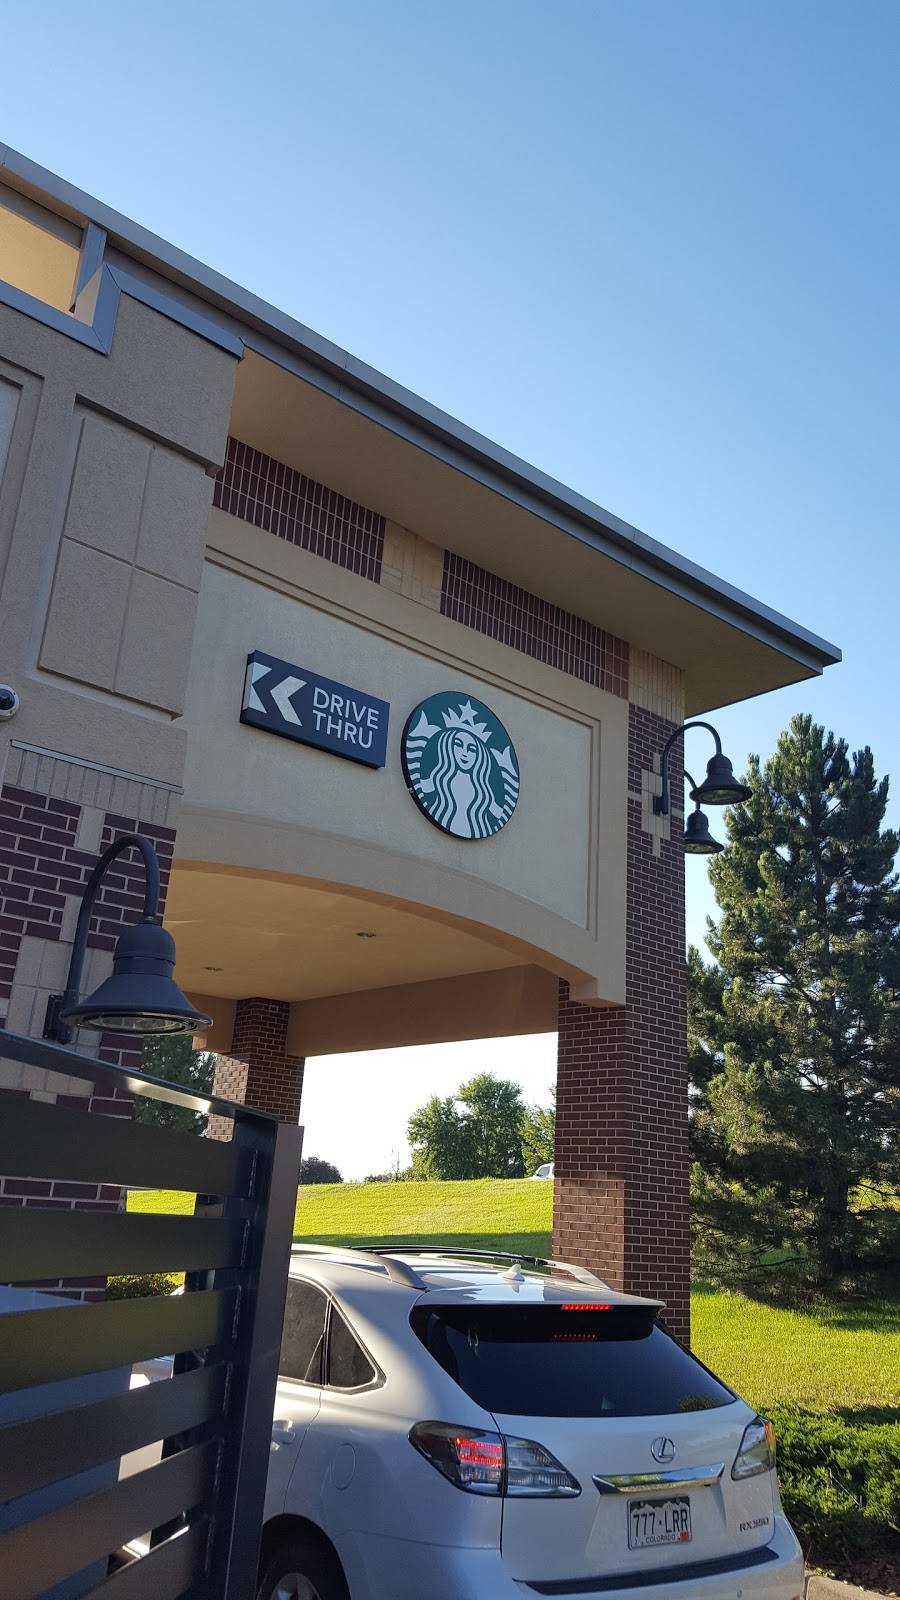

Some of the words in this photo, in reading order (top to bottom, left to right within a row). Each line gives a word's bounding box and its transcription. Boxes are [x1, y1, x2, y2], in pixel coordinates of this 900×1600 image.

[312, 687, 380, 730] DRIVE
[312, 709, 373, 749] THRU
[645, 1533, 677, 1544] COLORADO
